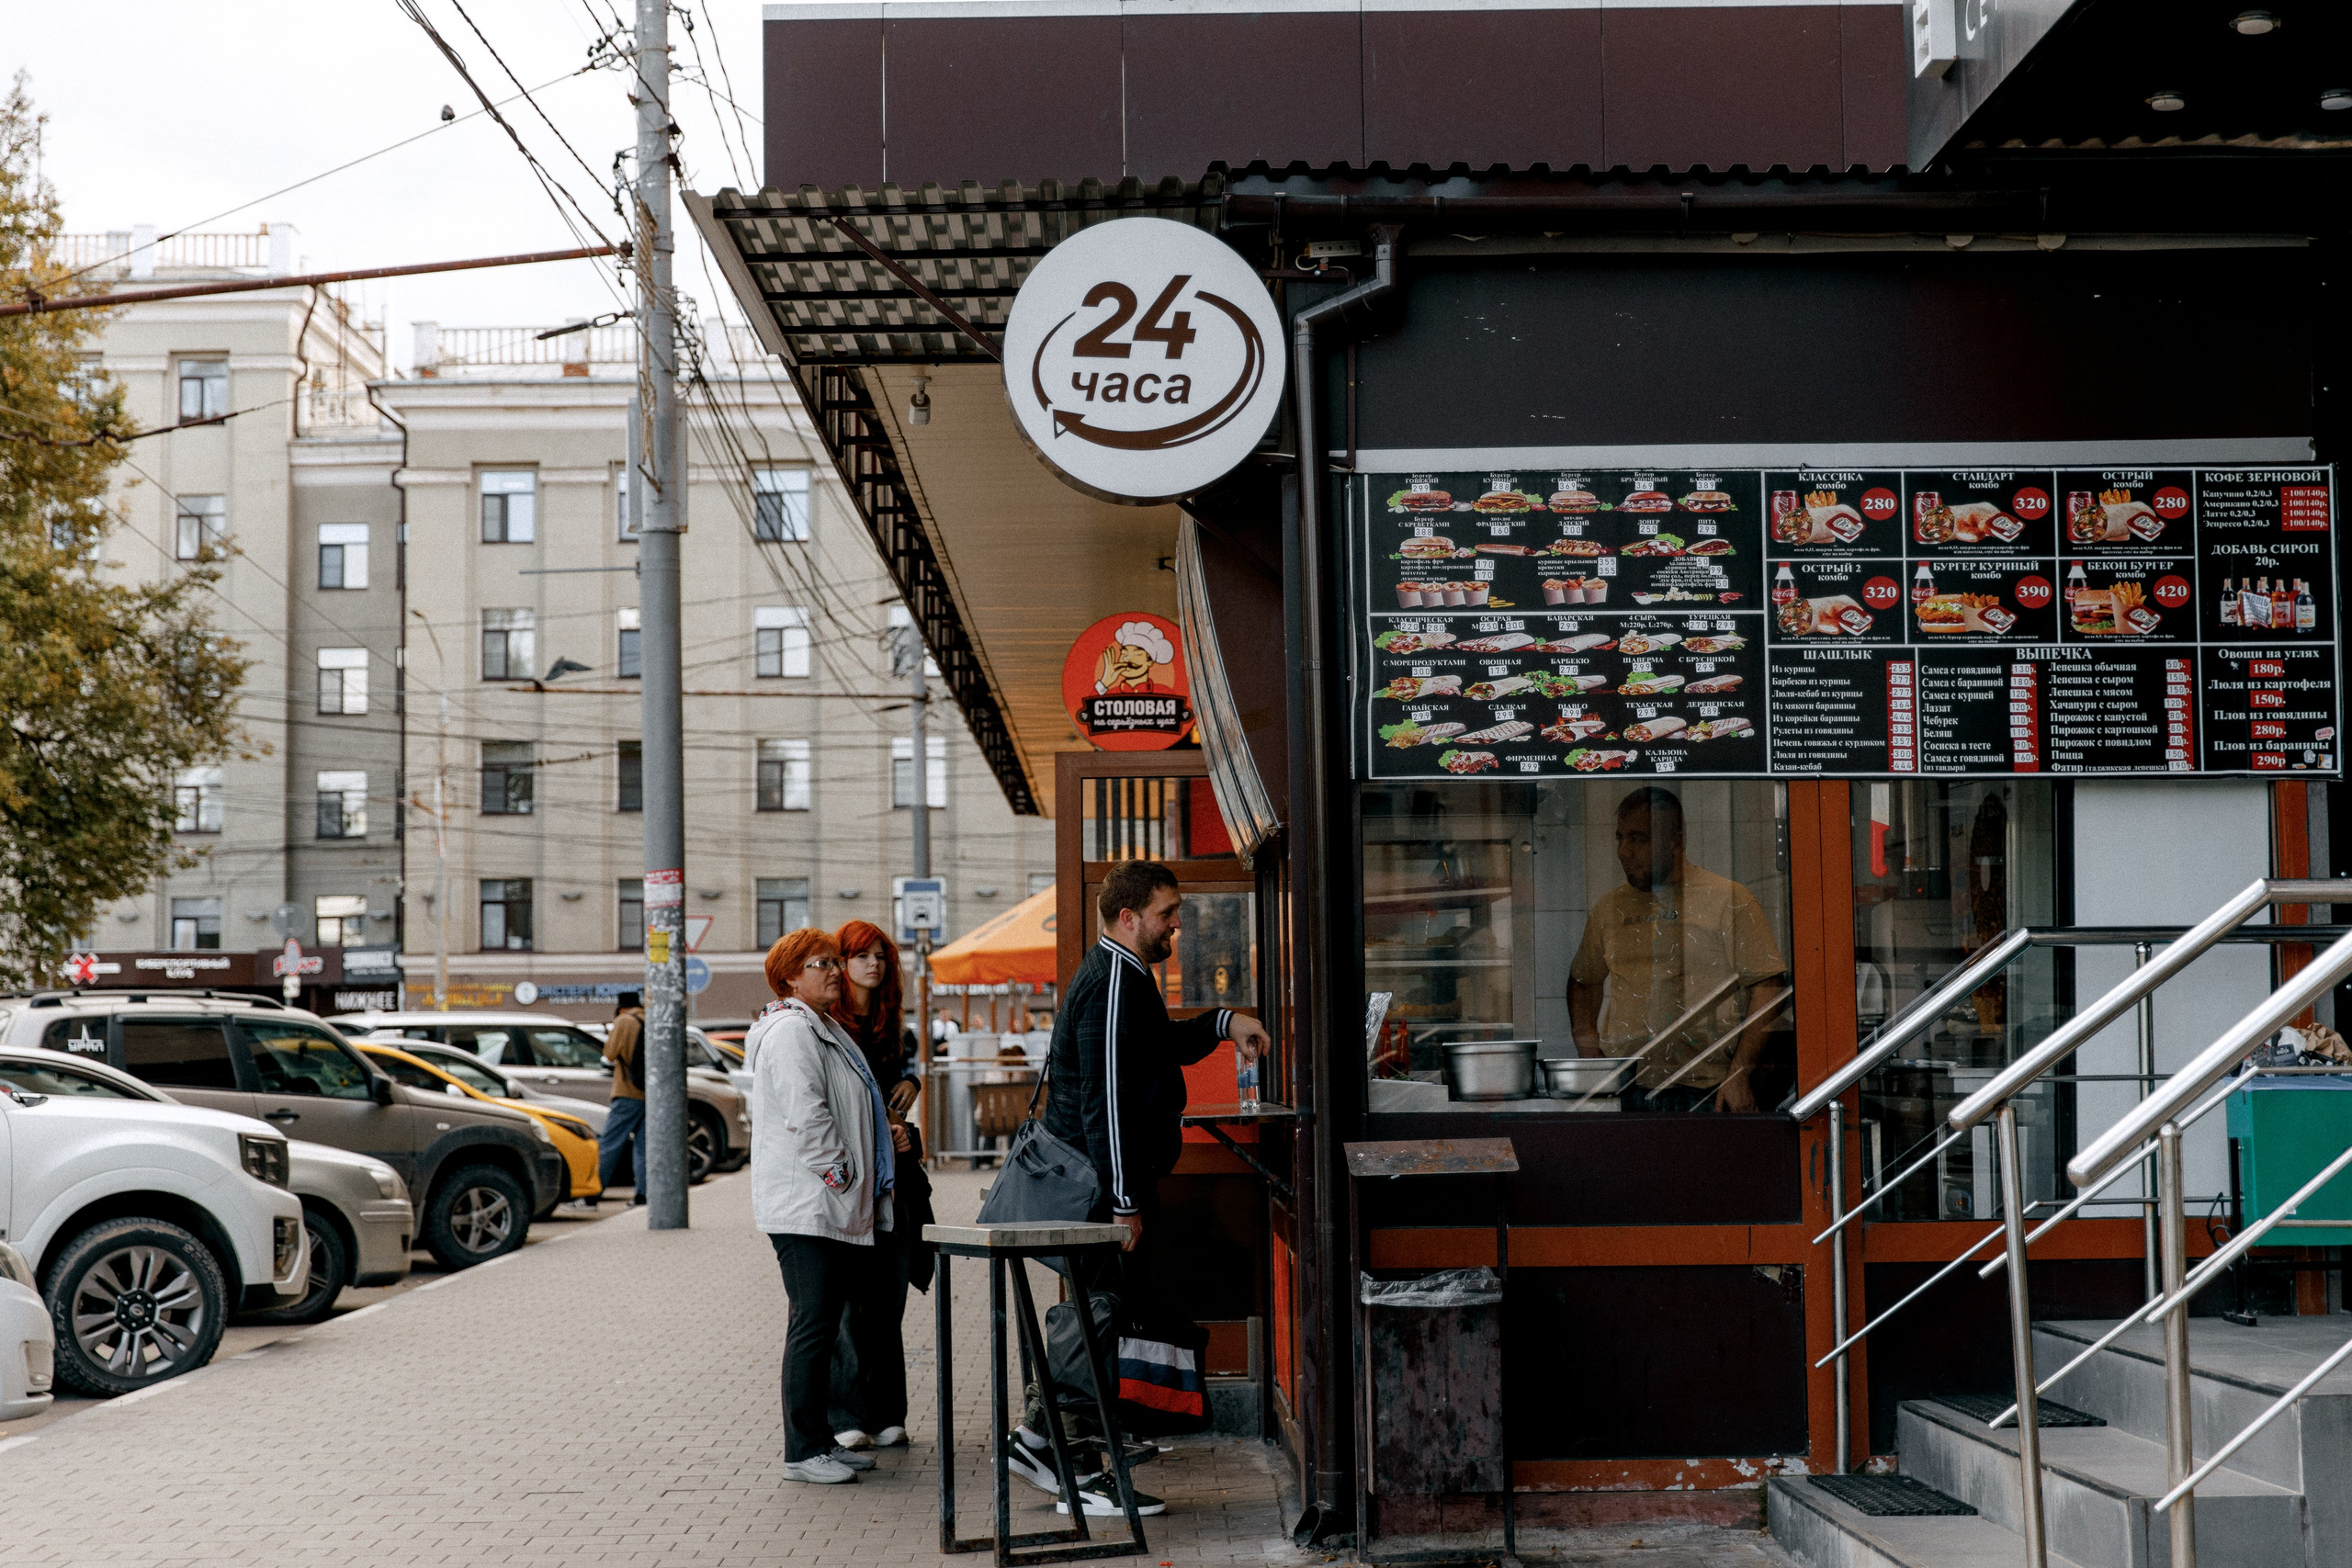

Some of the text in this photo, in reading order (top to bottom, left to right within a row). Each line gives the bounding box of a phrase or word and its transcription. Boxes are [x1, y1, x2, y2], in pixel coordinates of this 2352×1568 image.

[1072, 275, 1196, 359] 24
[1070, 372, 1192, 404] часа
[1798, 472, 1864, 482] КЛАССИКА
[1952, 472, 2013, 482] СТАНДАРТ
[2102, 469, 2154, 480] ОСТРЫЙ
[2205, 470, 2322, 482] КОФЕ ЗЕРНОВОЙ
[1969, 479, 1999, 489] комбо
[2113, 479, 2143, 488] комбо
[2202, 490, 2245, 499] Капучино
[1864, 498, 1894, 510] 280
[2016, 498, 2046, 509] 320
[2156, 497, 2186, 508] 280
[2202, 500, 2251, 509] Американо
[2202, 510, 2229, 518] Латте
[2202, 520, 2242, 529] Эспрессо
[2211, 544, 2319, 555] ДОБАВЬ СИРОП
[1932, 560, 2040, 571] БУРГЕР КУРИНЫЙ
[2087, 561, 2174, 571] БЕКОН БУРГЕР
[2256, 557, 2279, 568] 20р.
[1802, 562, 1861, 575] ОСТРЫЙ 2
[1971, 570, 2001, 579] комбо
[1866, 586, 1896, 598] 320
[2018, 586, 2049, 598] 390
[2156, 585, 2188, 597] 420
[1804, 650, 1872, 660] ШАШЛЫК
[2016, 648, 2092, 660] ВЫПЕЧКА
[2218, 649, 2262, 659] Овощи
[2284, 650, 2319, 660] углях
[1479, 659, 1521, 667] ОВОЩНАЯ
[1551, 658, 1589, 666] БАРБЕКЮ
[1686, 656, 1735, 664] БРУСНИКОЙ
[1560, 667, 1577, 675] 270
[1921, 665, 1949, 674] Самса
[1957, 665, 2001, 674] говядиной
[2048, 661, 2136, 671] Лепешка обычная
[2254, 664, 2285, 676] 180р.
[1772, 677, 1807, 687] Барбекю
[1819, 679, 1850, 687] курицы
[2049, 674, 2093, 684] Лепешка
[2102, 677, 2133, 686] сыром
[2208, 680, 2244, 689] Люля
[2265, 679, 2331, 691] картофеля
[1922, 691, 1950, 700] Самса
[1958, 691, 1994, 702] курицей
[2255, 694, 2286, 706] 150р.
[1094, 700, 1176, 716] СТОЛОВАЯ
[1922, 703, 1951, 712] Лаззат
[2050, 700, 2097, 711] Хачапури
[2107, 702, 2138, 711] сыром
[1413, 712, 1430, 721] 299
[1497, 711, 1514, 720] 299
[1638, 708, 1655, 716] 299
[2214, 710, 2246, 720] Плов
[2267, 711, 2327, 720] говядины
[1106, 716, 1155, 729] серьёзных
[1156, 718, 1176, 728] щах
[1923, 716, 1958, 728] Чебурек
[2051, 713, 2095, 724] Пирожок
[2104, 713, 2147, 724] капустой
[1924, 728, 1952, 738] Беляш
[2051, 725, 2095, 737] Пирожок
[2105, 725, 2158, 737] картошкой
[2255, 725, 2287, 737] 280р.
[1773, 739, 1803, 747] Печень
[1845, 740, 1885, 749] курдюком
[1923, 740, 1959, 750] Сосиска
[2214, 740, 2245, 750] Плов
[2266, 739, 2329, 751] баранины
[2052, 750, 2083, 760] Пицца
[1521, 762, 1538, 771] 299
[1657, 762, 1673, 771] 299
[1774, 762, 1822, 771] Казан-кебаб
[2257, 756, 2286, 767] 290р
[2052, 763, 2083, 773] Фатир
